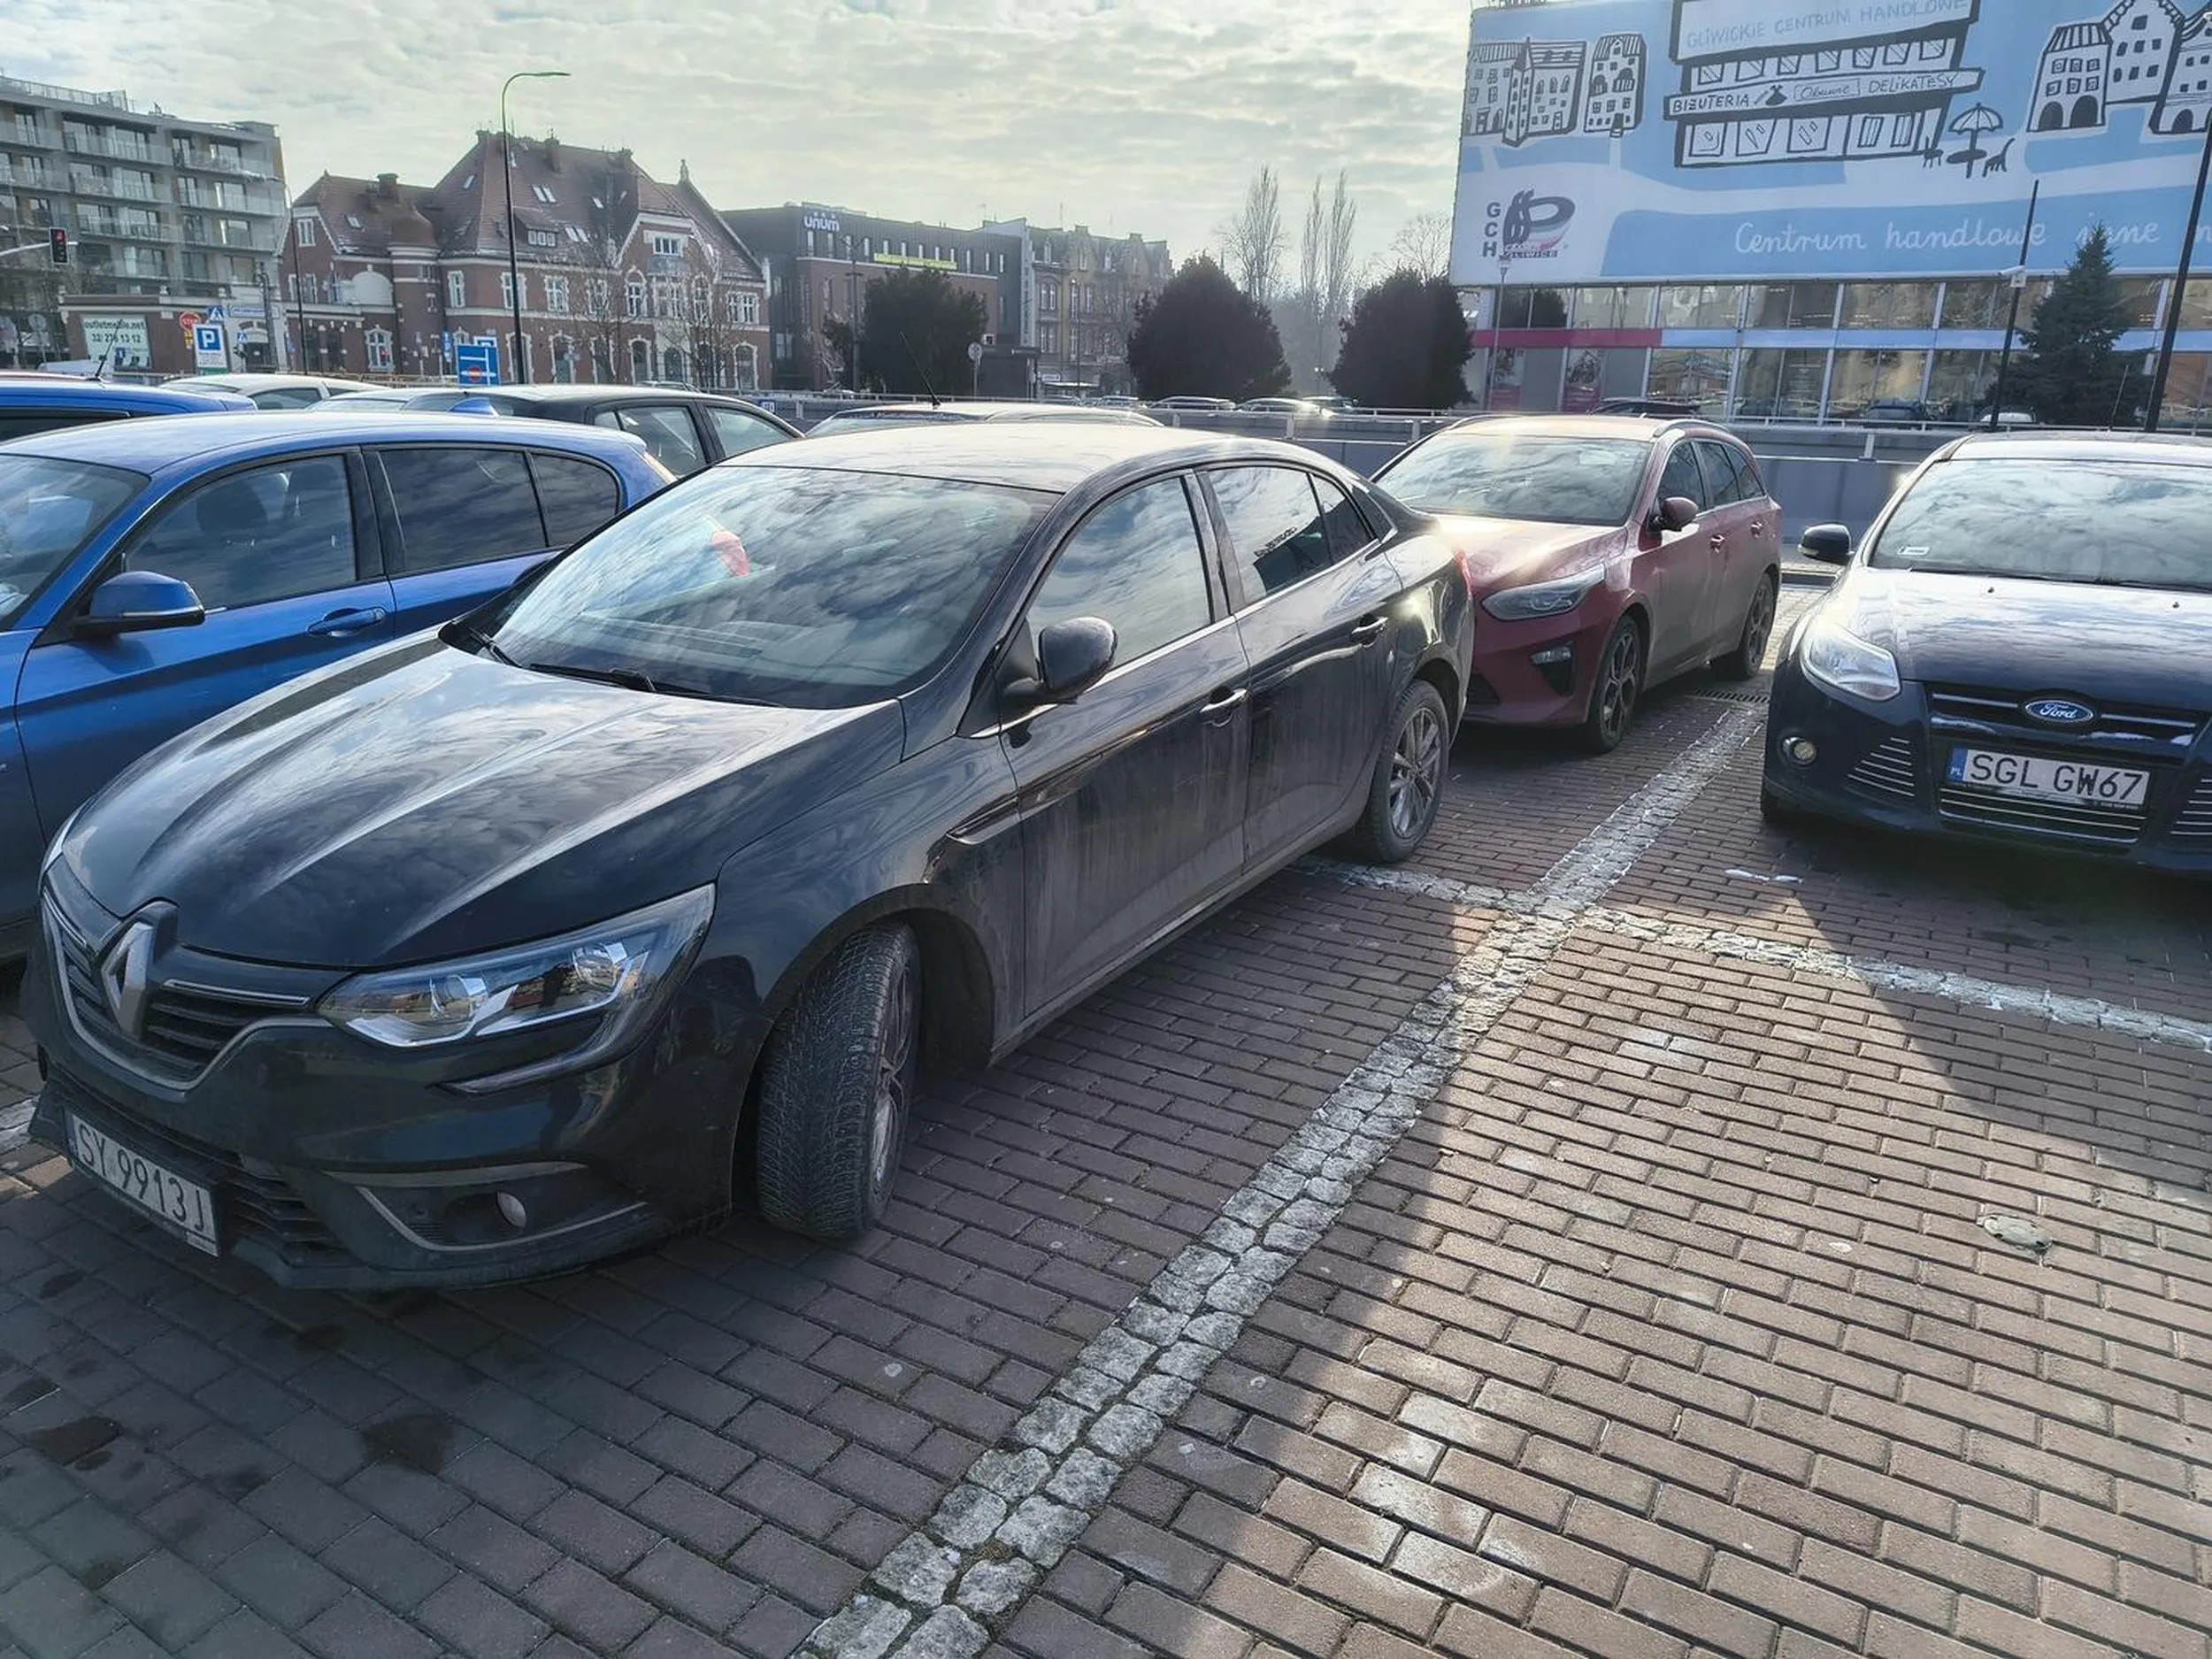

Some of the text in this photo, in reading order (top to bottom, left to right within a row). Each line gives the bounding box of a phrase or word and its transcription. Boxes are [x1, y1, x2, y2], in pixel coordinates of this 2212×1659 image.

[1775, 9, 1851, 34] CENTRUM
[1735, 221, 1866, 252] Centrum
[202, 330, 215, 348] P
[2039, 702, 2078, 719] Ford
[1970, 754, 2143, 801] SGL GW67
[80, 1123, 107, 1178] SY
